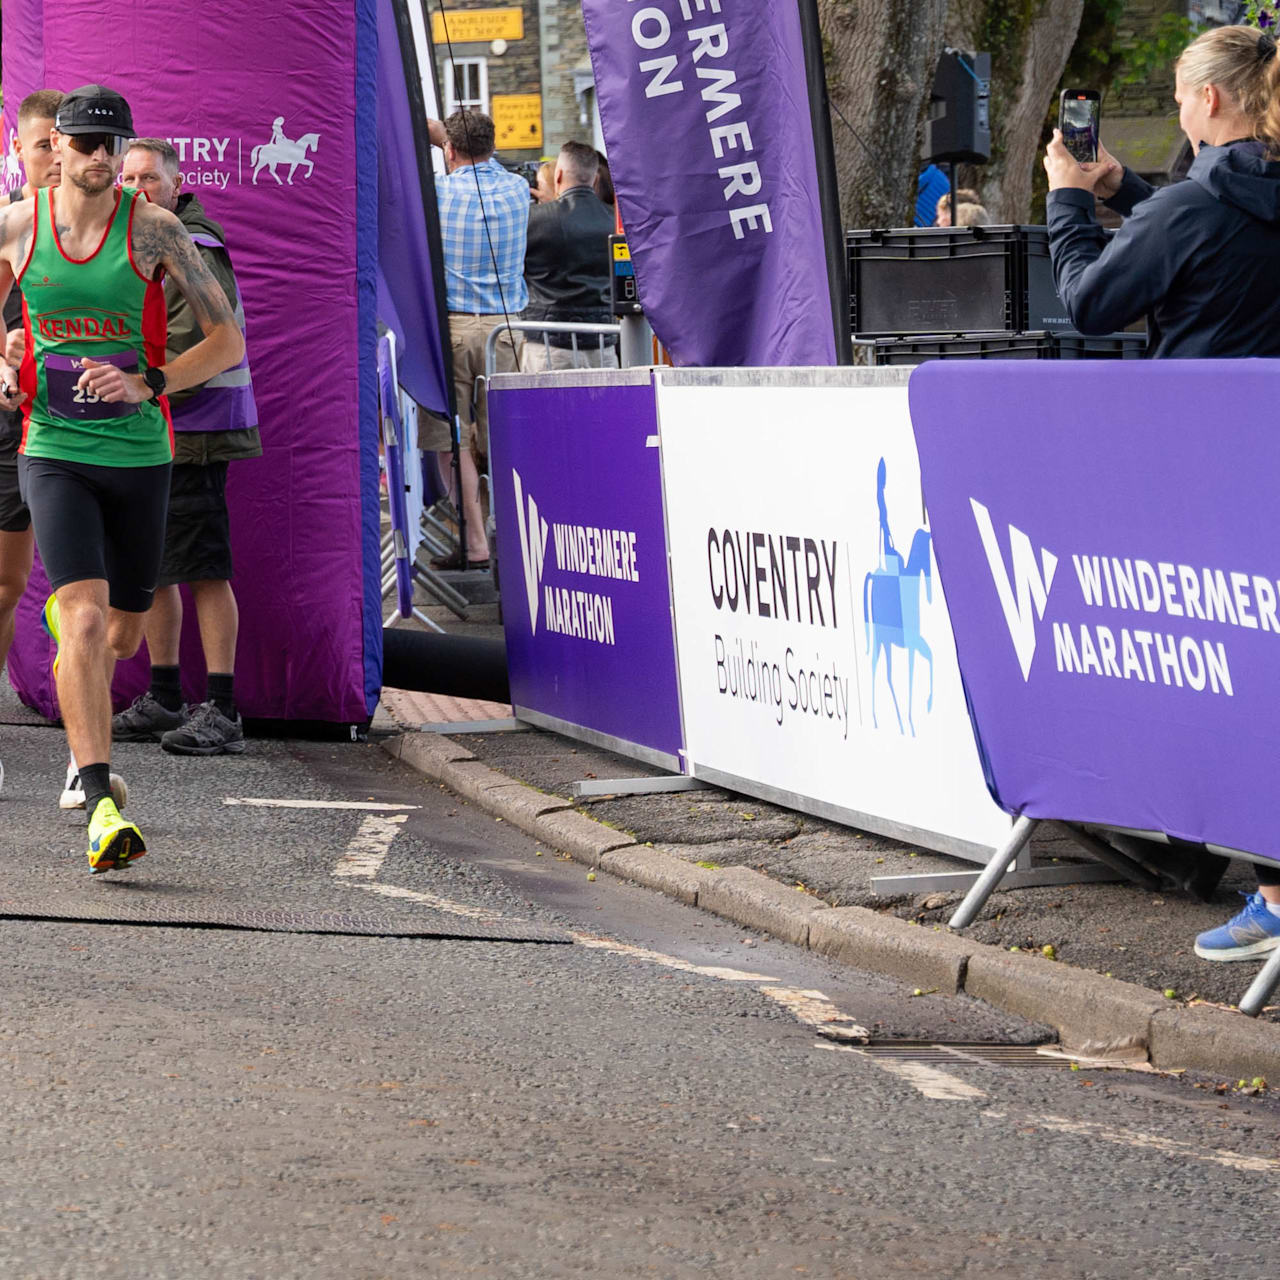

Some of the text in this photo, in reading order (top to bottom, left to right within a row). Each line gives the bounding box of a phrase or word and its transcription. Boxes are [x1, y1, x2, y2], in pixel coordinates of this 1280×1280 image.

[180, 167, 231, 190] ociety
[37, 318, 131, 338] KENDAL
[72, 386, 107, 404] 25
[552, 522, 640, 583] WINDERMERE
[707, 527, 838, 629] COVENTRY
[544, 585, 615, 646] MARATHON
[1072, 553, 1280, 634] WINDERMER
[714, 634, 849, 741] Building Society
[1052, 622, 1234, 697] MARATHON
